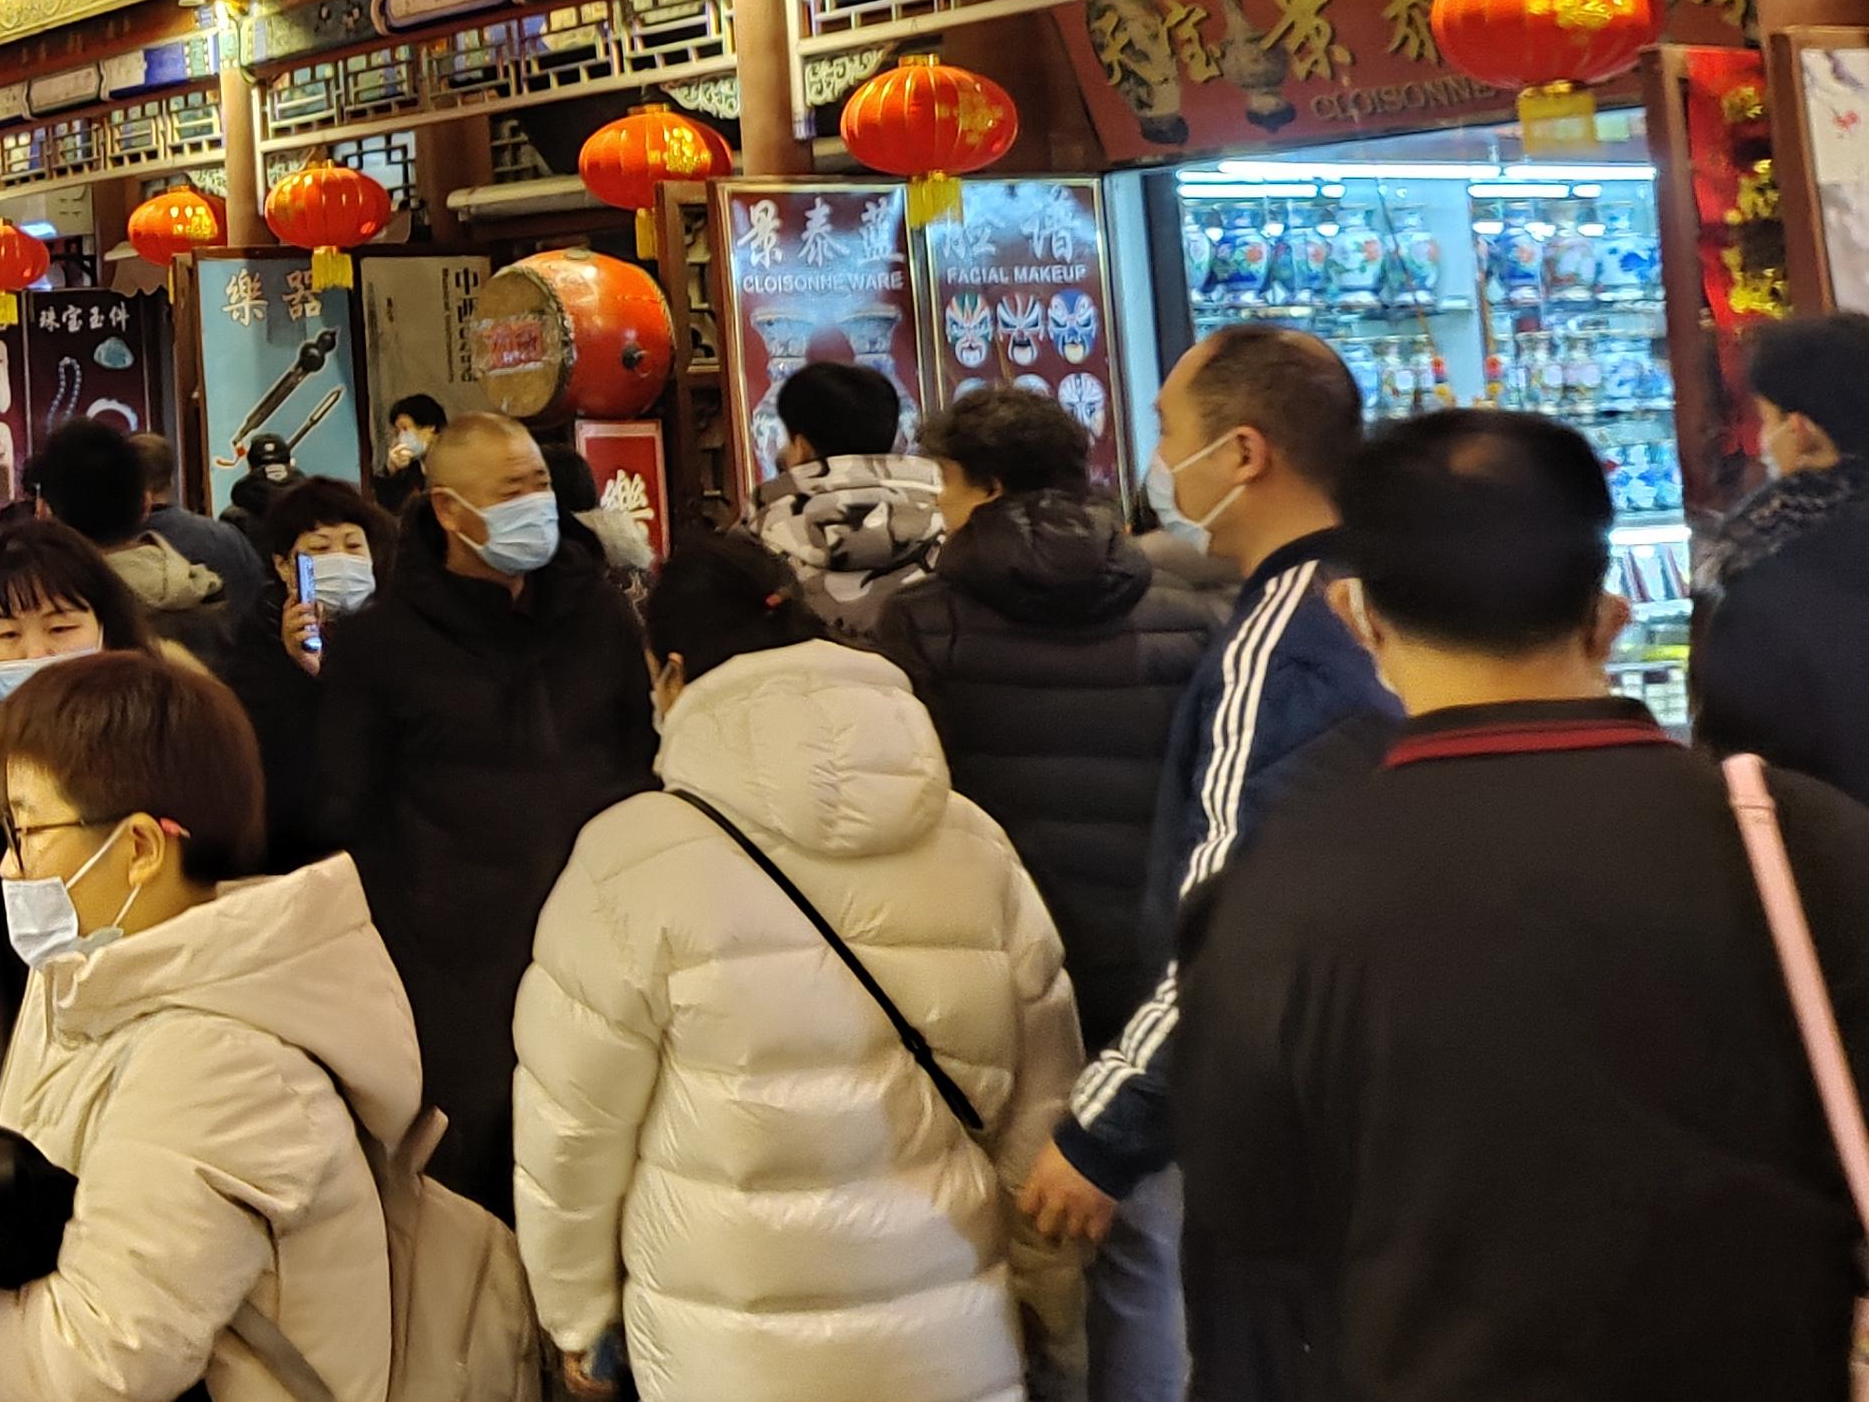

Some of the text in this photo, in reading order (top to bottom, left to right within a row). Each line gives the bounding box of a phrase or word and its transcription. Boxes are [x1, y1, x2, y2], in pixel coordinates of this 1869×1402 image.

[737, 196, 906, 271] 景泰蓝
[849, 271, 905, 291] WARE
[945, 263, 1090, 285] FACIAL MAKEUP
